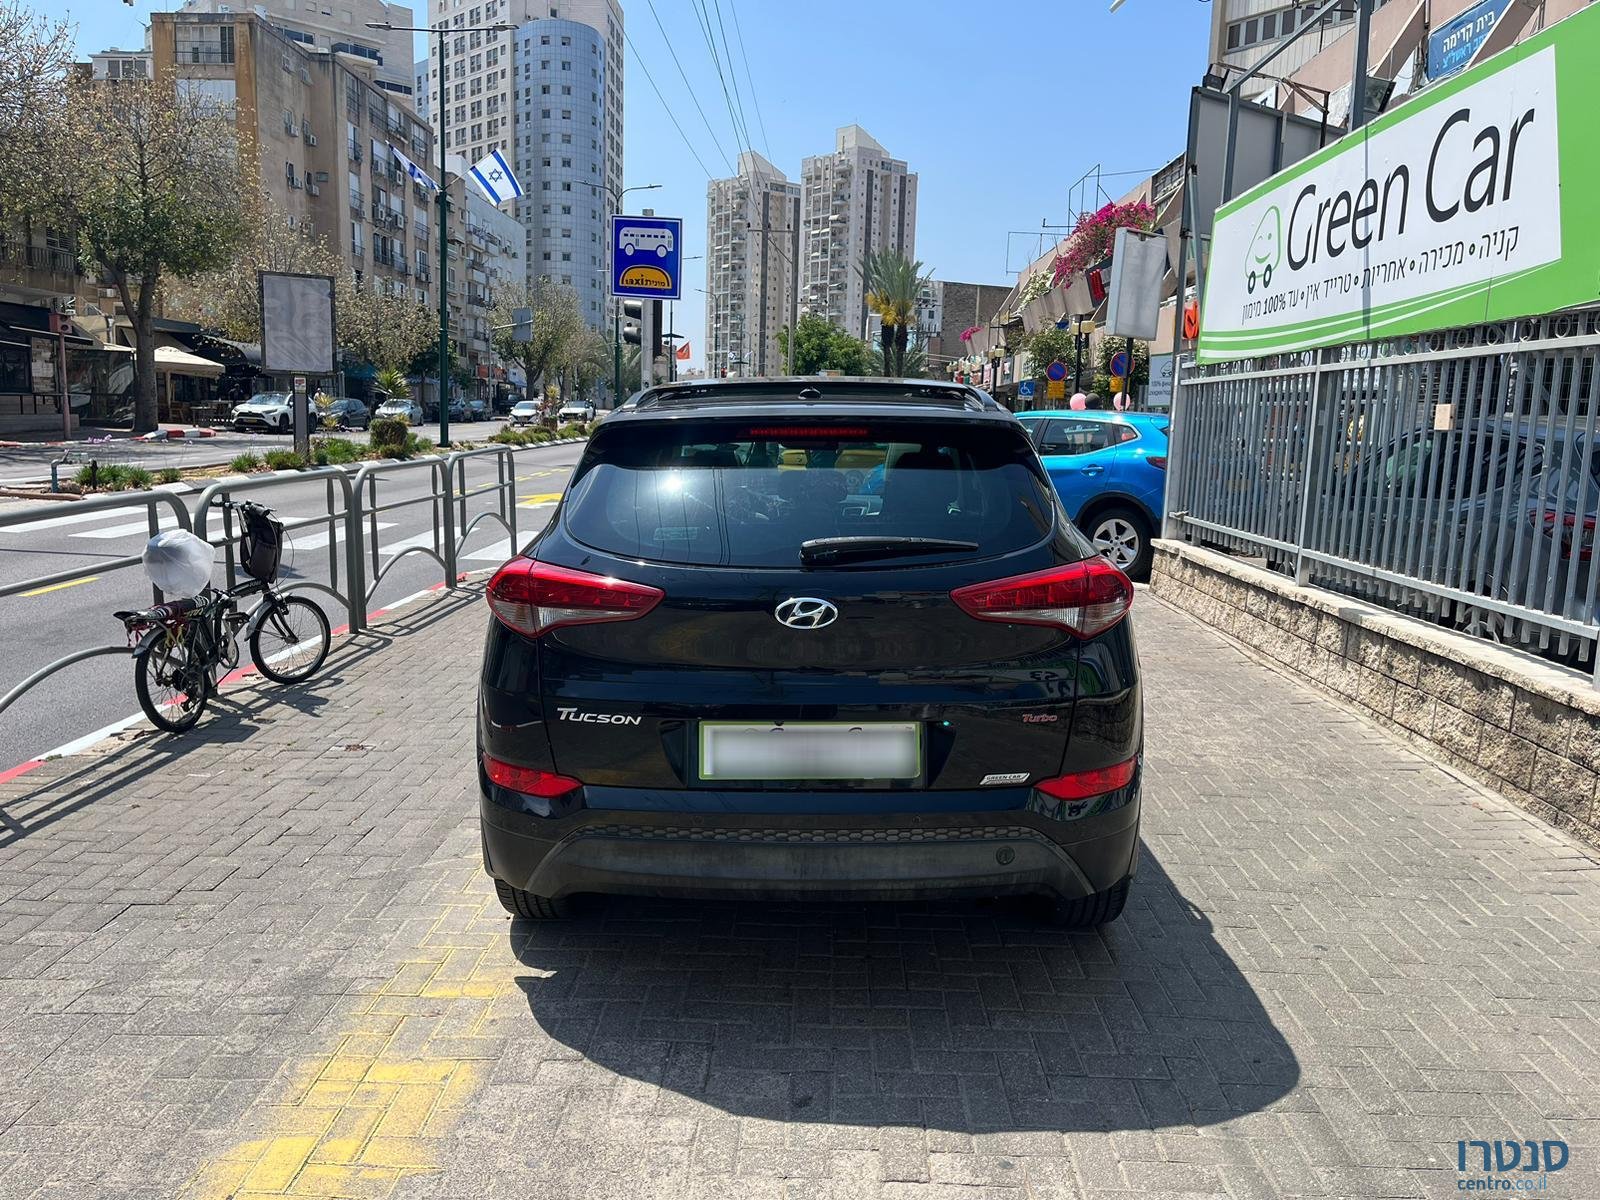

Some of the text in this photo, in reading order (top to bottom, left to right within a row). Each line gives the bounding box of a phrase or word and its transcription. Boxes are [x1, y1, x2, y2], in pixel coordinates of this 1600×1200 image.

[1443, 11, 1496, 53] בית קדימה
[1287, 108, 1535, 271] Green Car
[625, 274, 644, 286] taxi
[645, 278, 666, 287] מונית
[1241, 226, 1519, 326] קניה מכירה אחריות טרייד אין עד 100% מימון
[1022, 713, 1058, 723] Turbo
